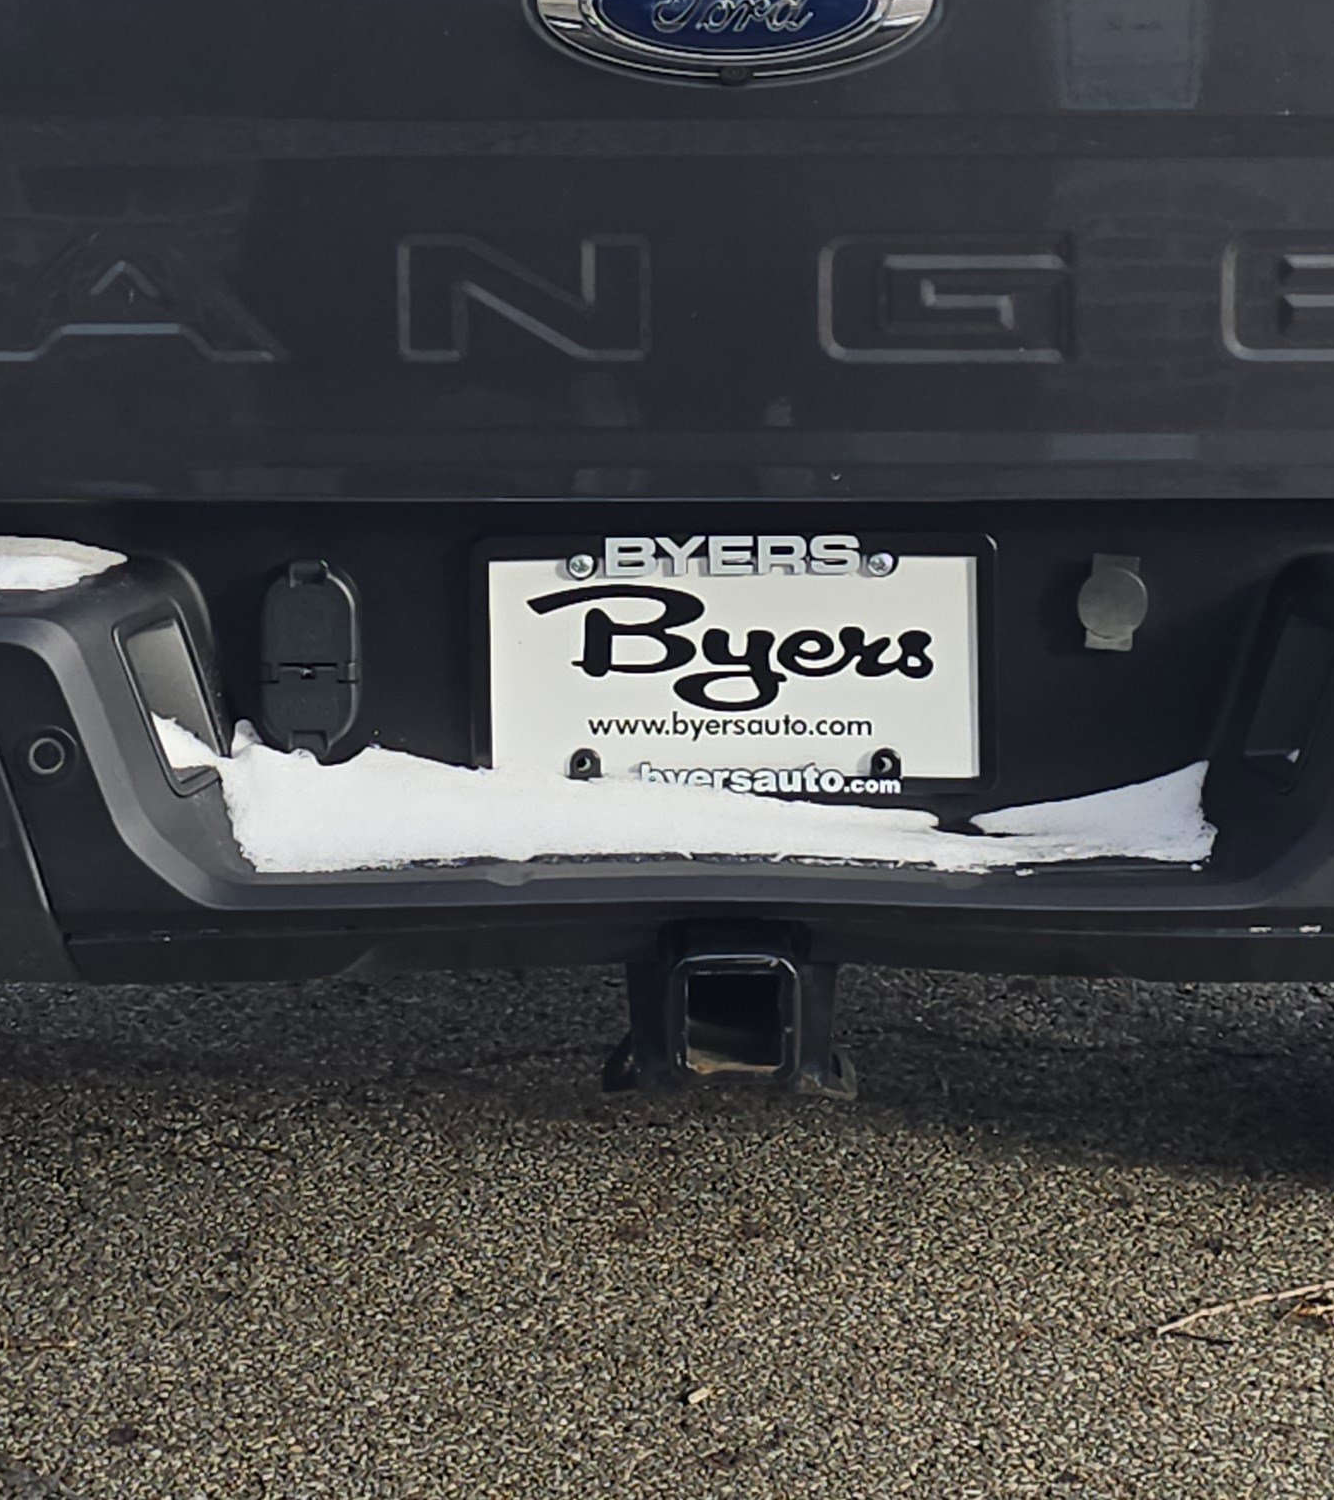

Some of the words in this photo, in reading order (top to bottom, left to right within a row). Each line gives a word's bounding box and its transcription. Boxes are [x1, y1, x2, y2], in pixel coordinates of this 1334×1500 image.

[602, 534, 861, 578] BYERS
[526, 583, 935, 712] Byers
[587, 711, 873, 742] www.byersauto.com
